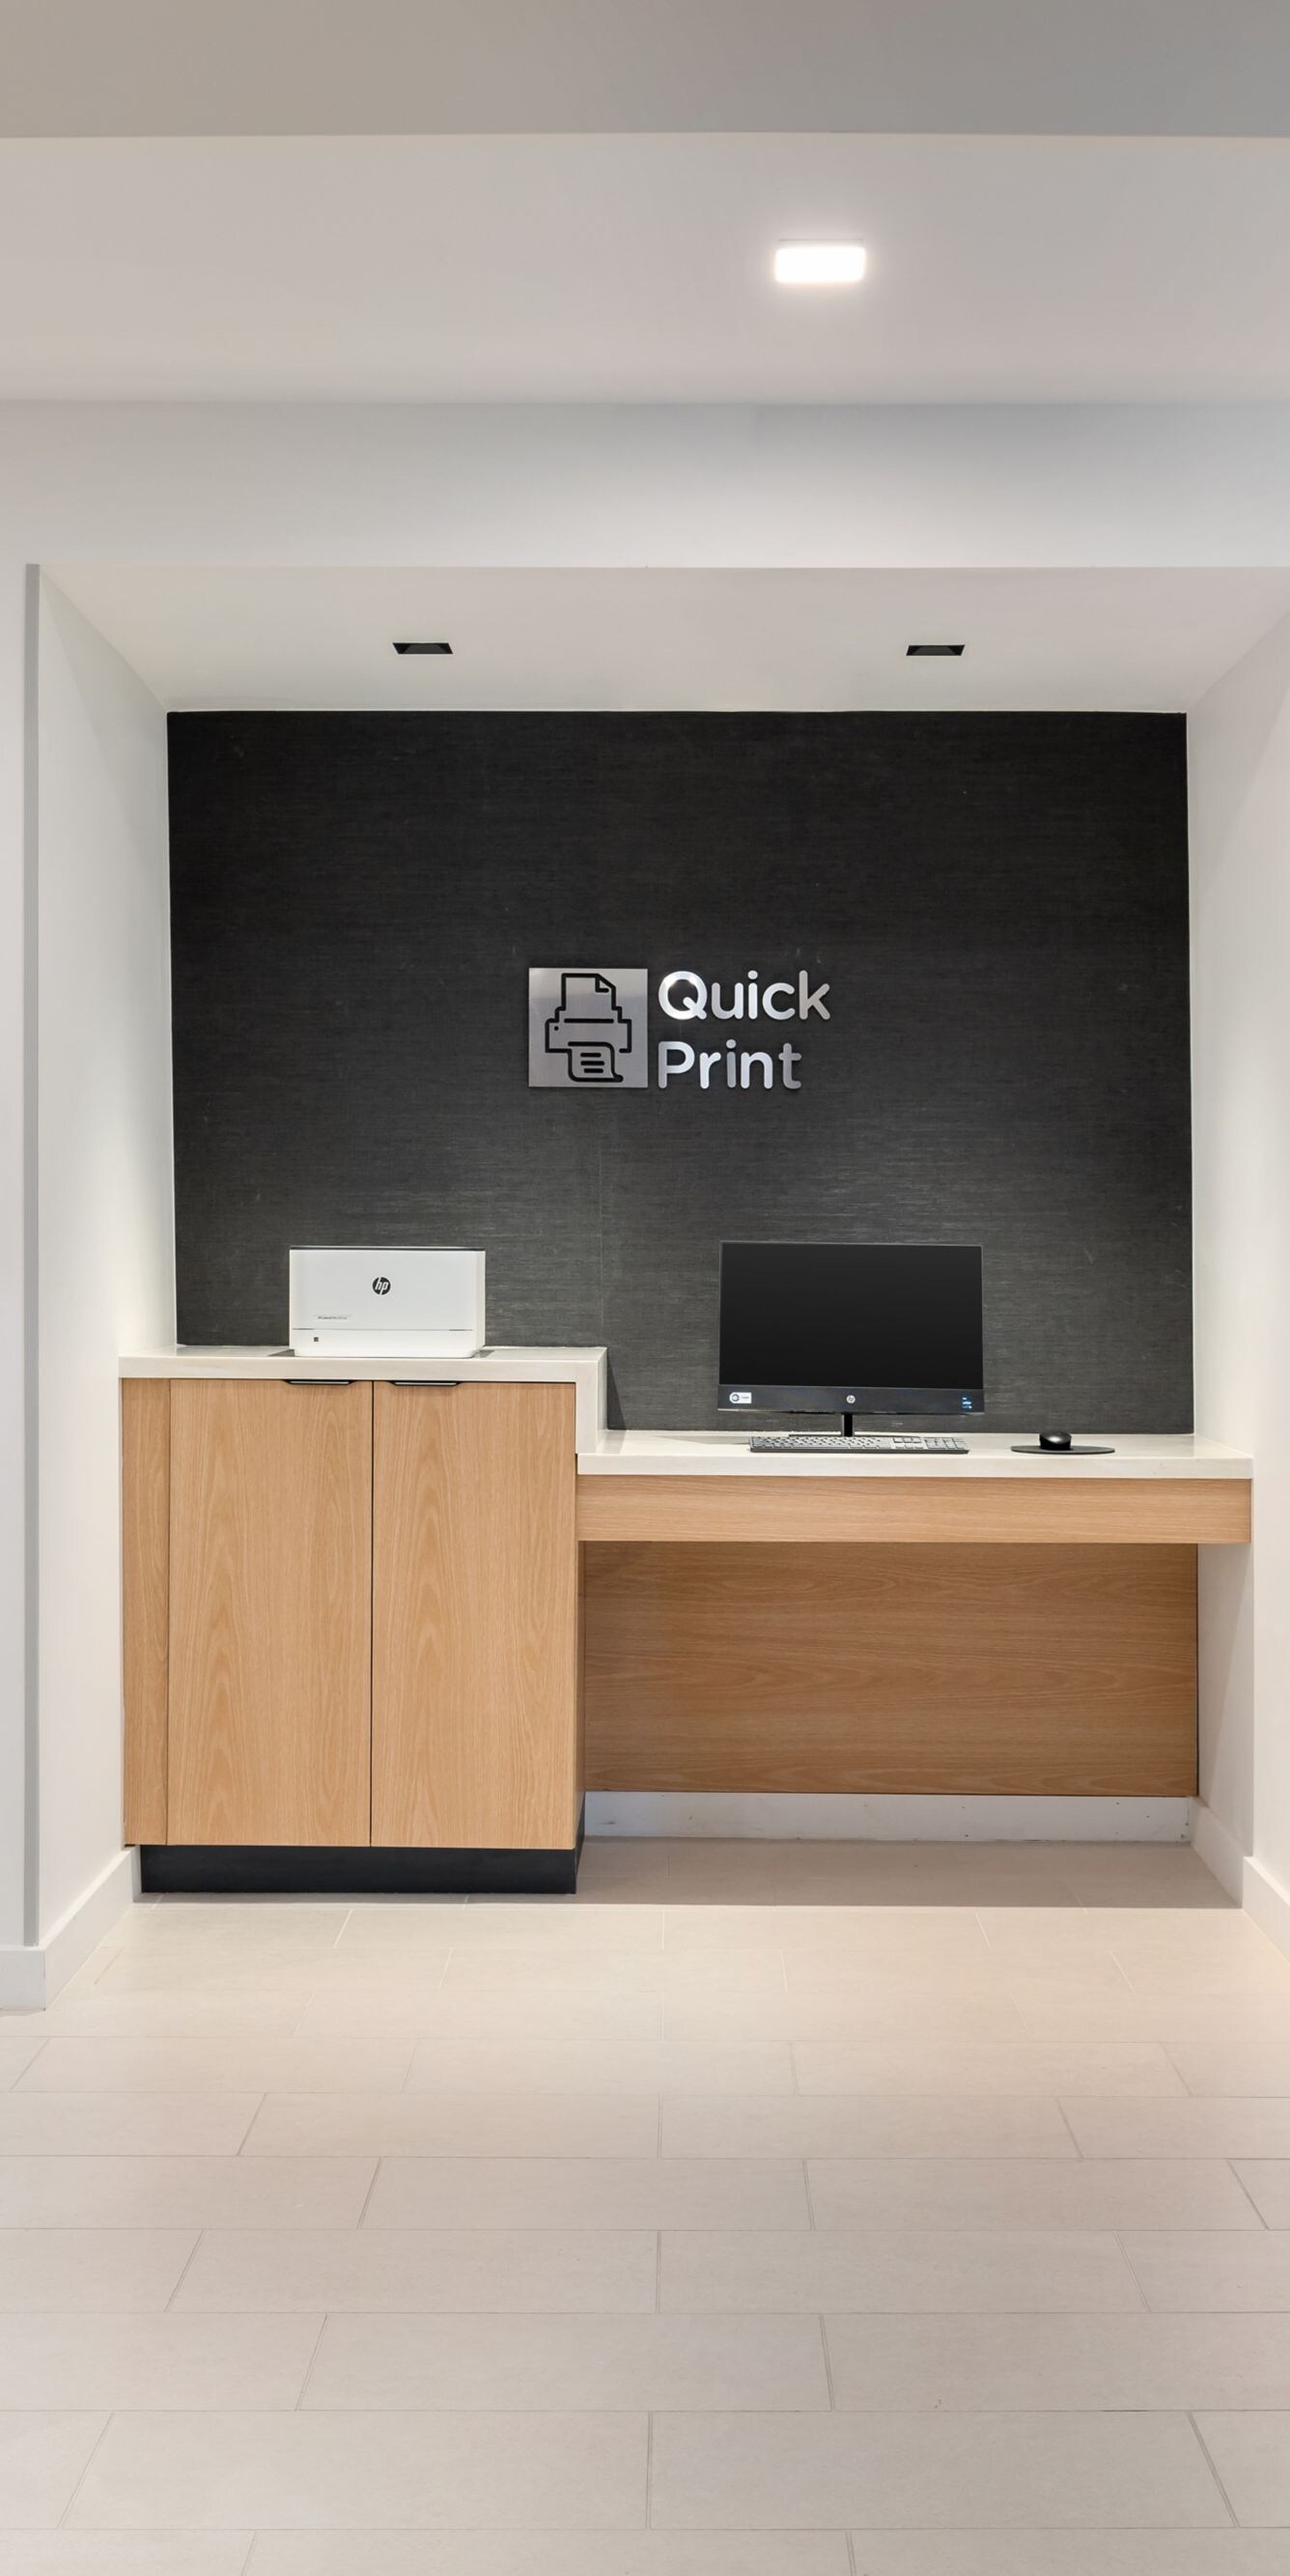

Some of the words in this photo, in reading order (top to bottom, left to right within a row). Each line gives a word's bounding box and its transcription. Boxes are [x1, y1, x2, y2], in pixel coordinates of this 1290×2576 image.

[658, 970, 830, 1020] Quick
[658, 1038, 802, 1090] Print
[373, 1276, 391, 1295] hp
